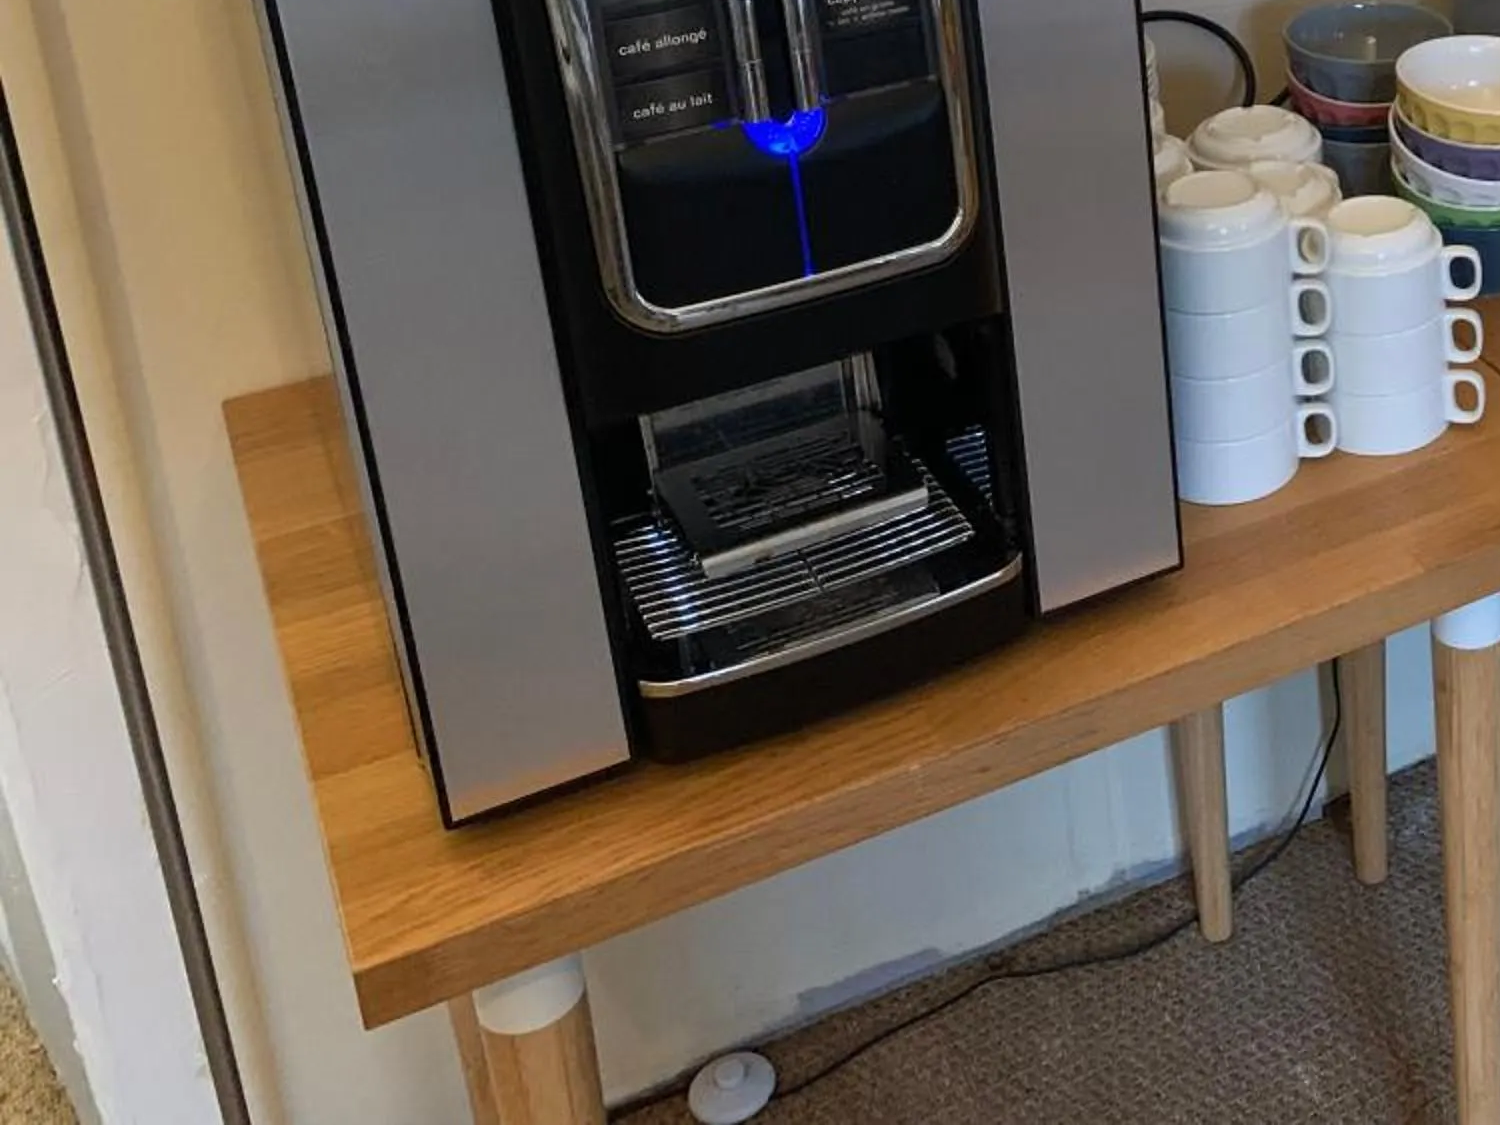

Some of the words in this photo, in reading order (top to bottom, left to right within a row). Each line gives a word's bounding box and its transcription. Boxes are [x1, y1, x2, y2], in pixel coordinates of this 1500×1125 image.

[618, 38, 651, 56] café
[655, 27, 708, 50] allongé
[633, 101, 665, 119] café
[669, 99, 687, 112] au
[690, 92, 713, 108] lait
